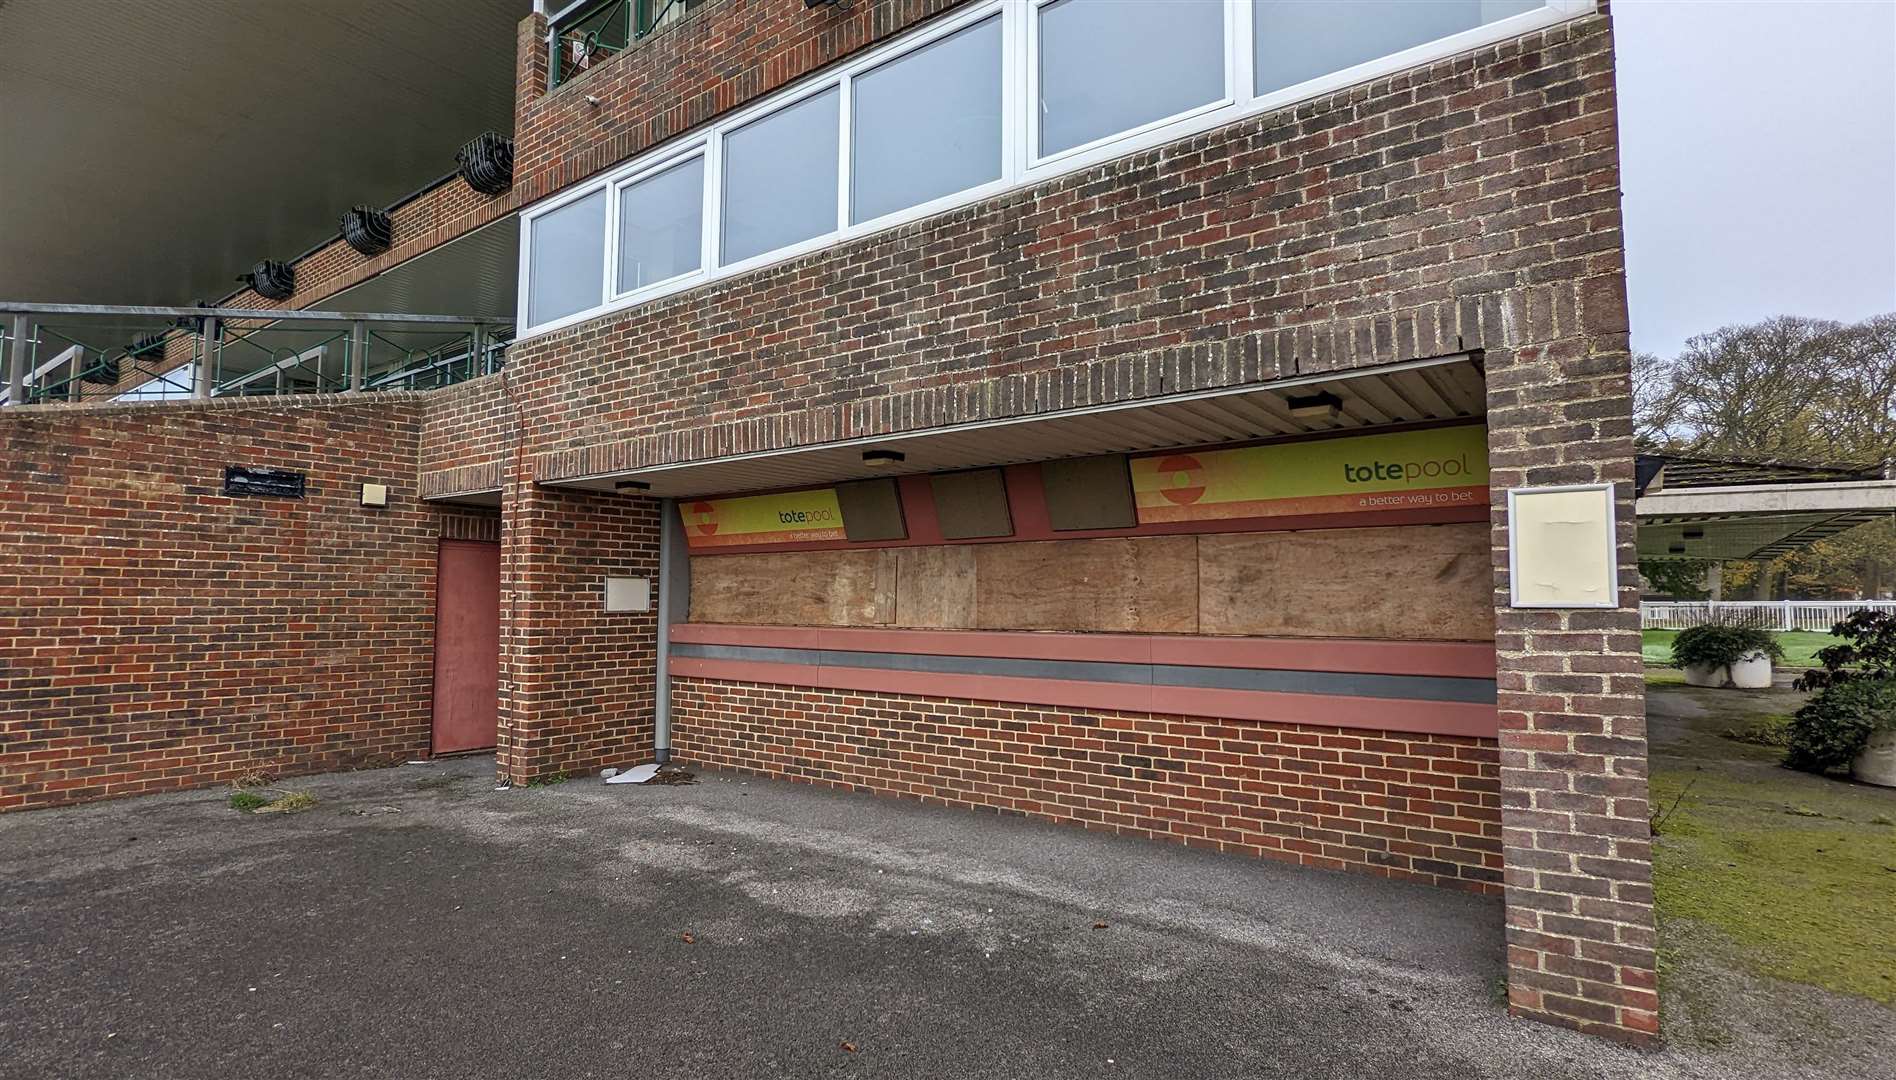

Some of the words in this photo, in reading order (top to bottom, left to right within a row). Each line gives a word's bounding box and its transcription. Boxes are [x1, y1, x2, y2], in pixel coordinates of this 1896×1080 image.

[1344, 453, 1472, 484] totepool
[1359, 498, 1367, 506] a
[1368, 496, 1404, 506] better
[1407, 495, 1432, 505] way
[1435, 492, 1449, 502] to
[1451, 491, 1473, 501] bet
[779, 508, 834, 525] totepool
